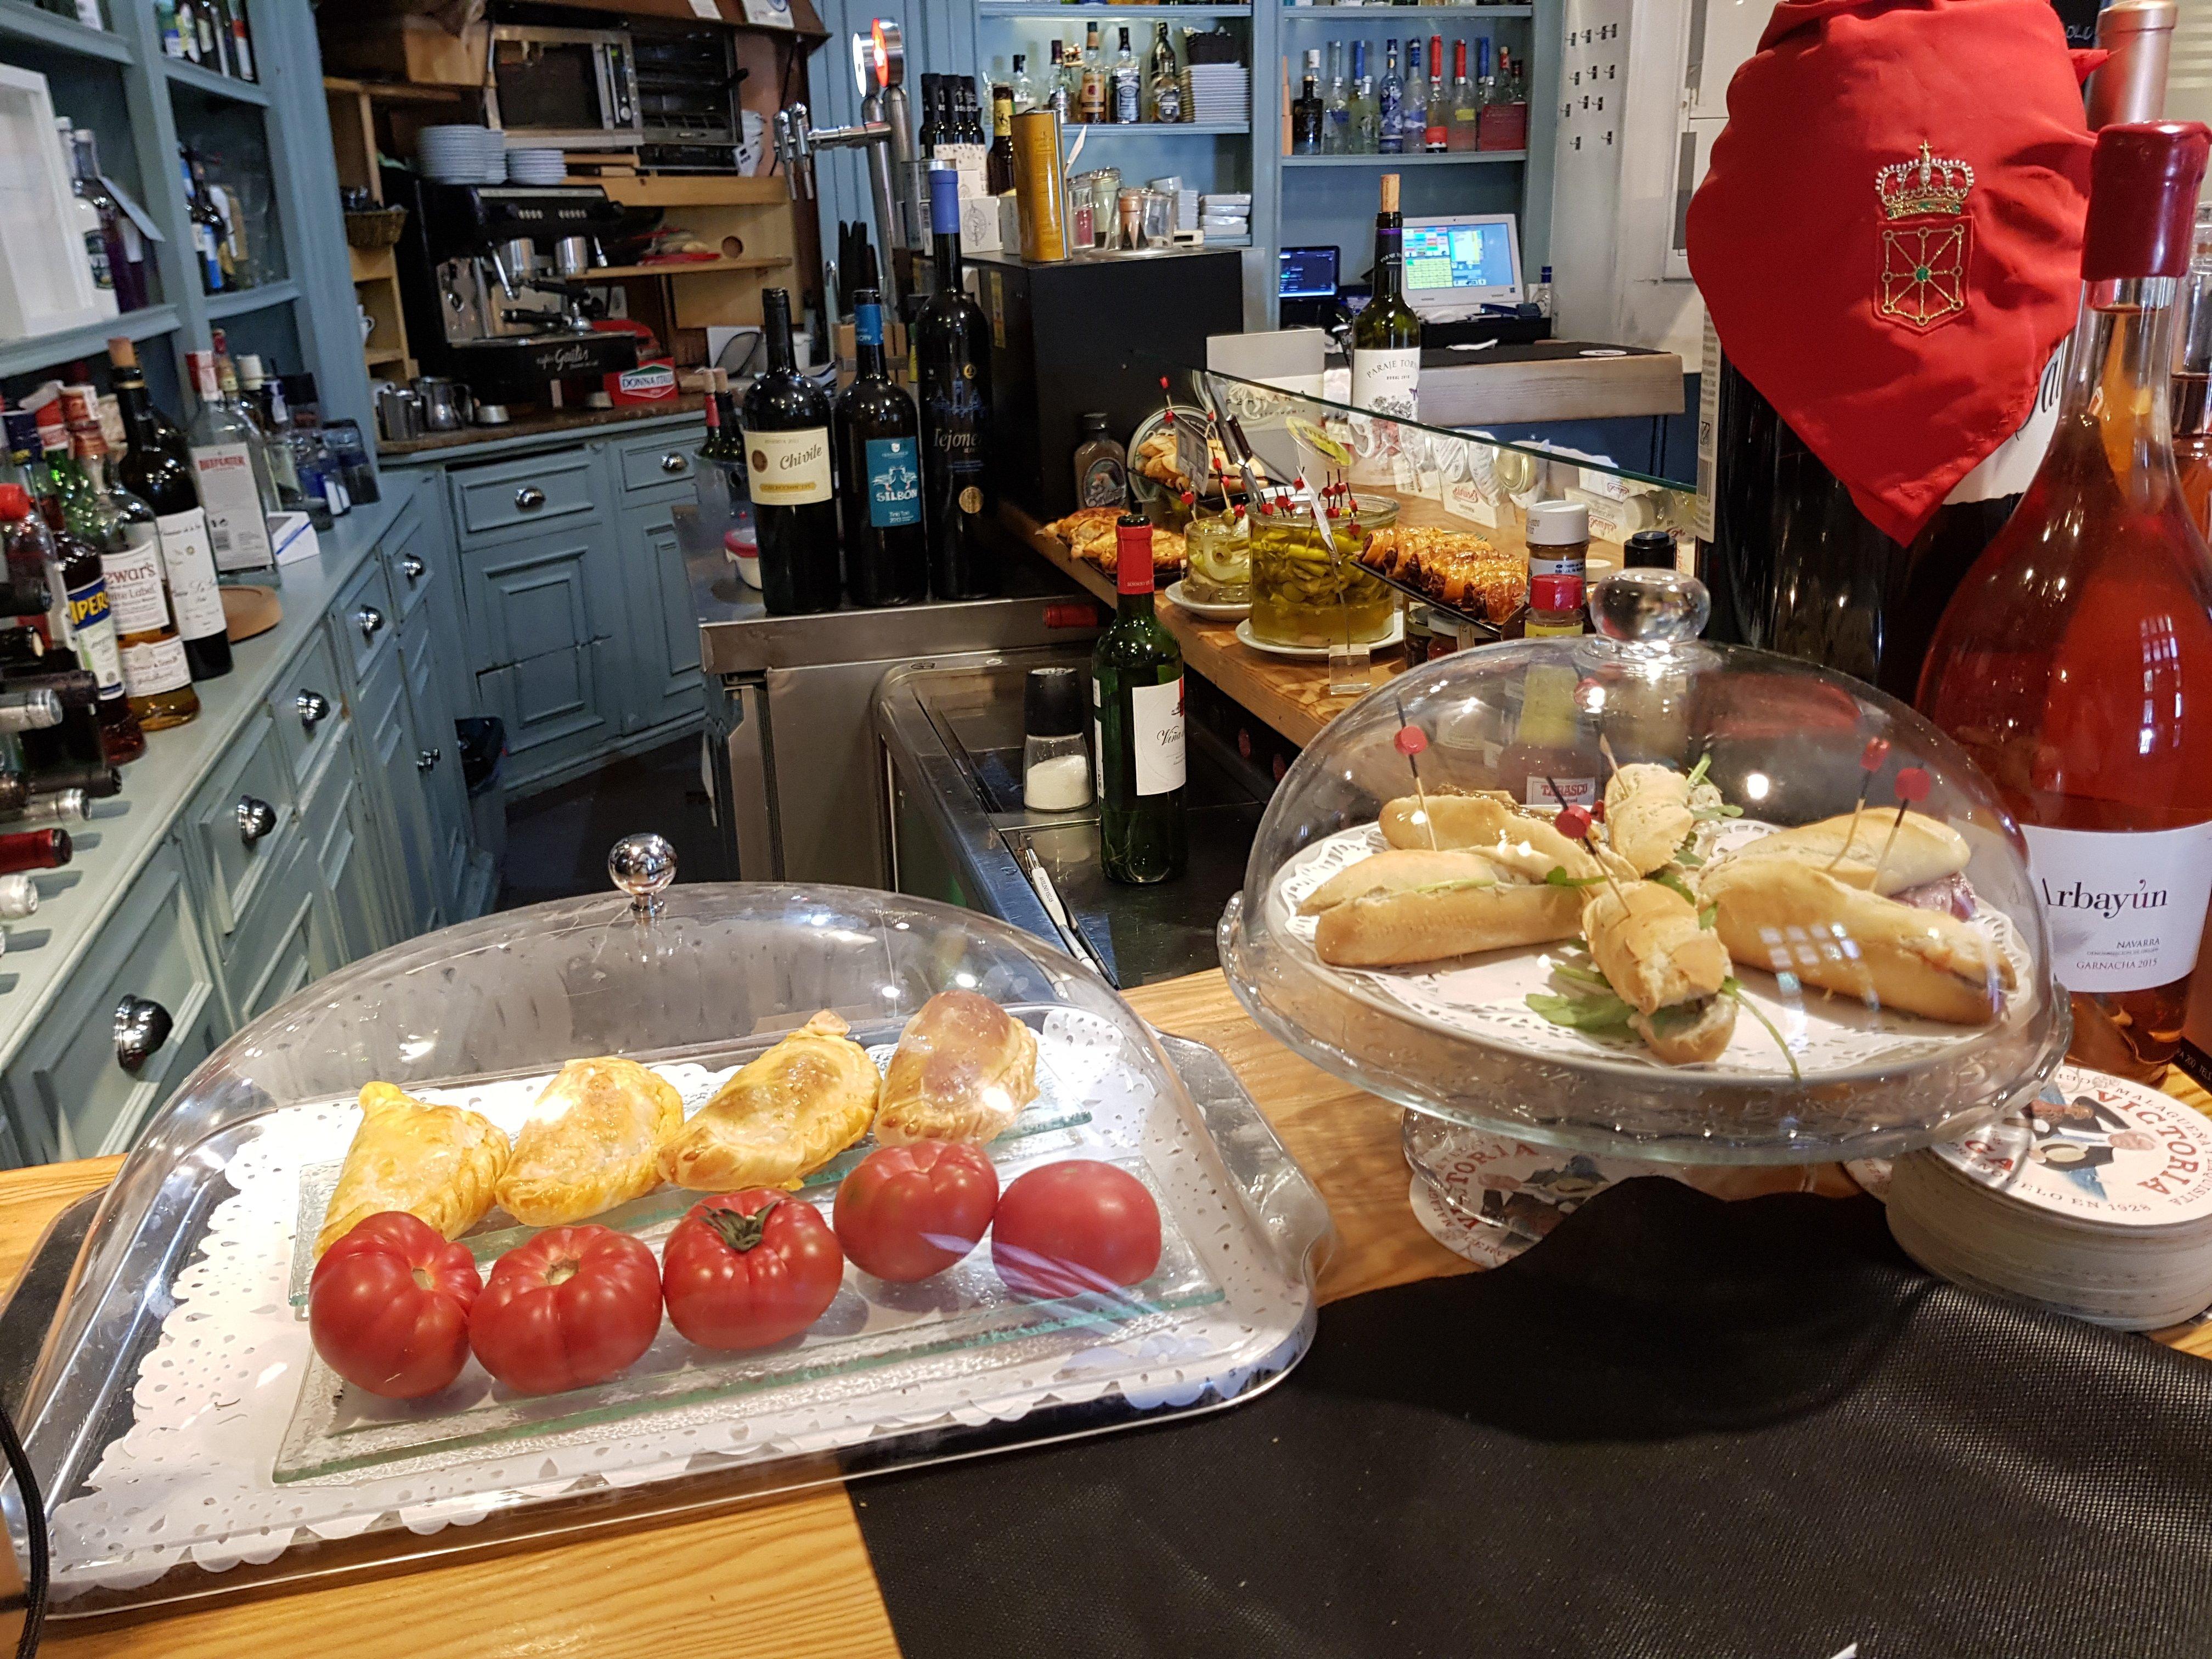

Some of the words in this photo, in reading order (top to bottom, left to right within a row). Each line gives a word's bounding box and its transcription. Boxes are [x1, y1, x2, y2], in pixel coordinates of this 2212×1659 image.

[1367, 360, 1397, 379] PARAJE
[780, 443, 823, 470] Chivite
[2117, 938, 2160, 949] NAVARRA
[2076, 961, 2136, 970] GARNACHA
[2138, 958, 2158, 968] 2015
[2096, 1090, 2199, 1195] VICTORIA
[2072, 1198, 2099, 1209] EN
